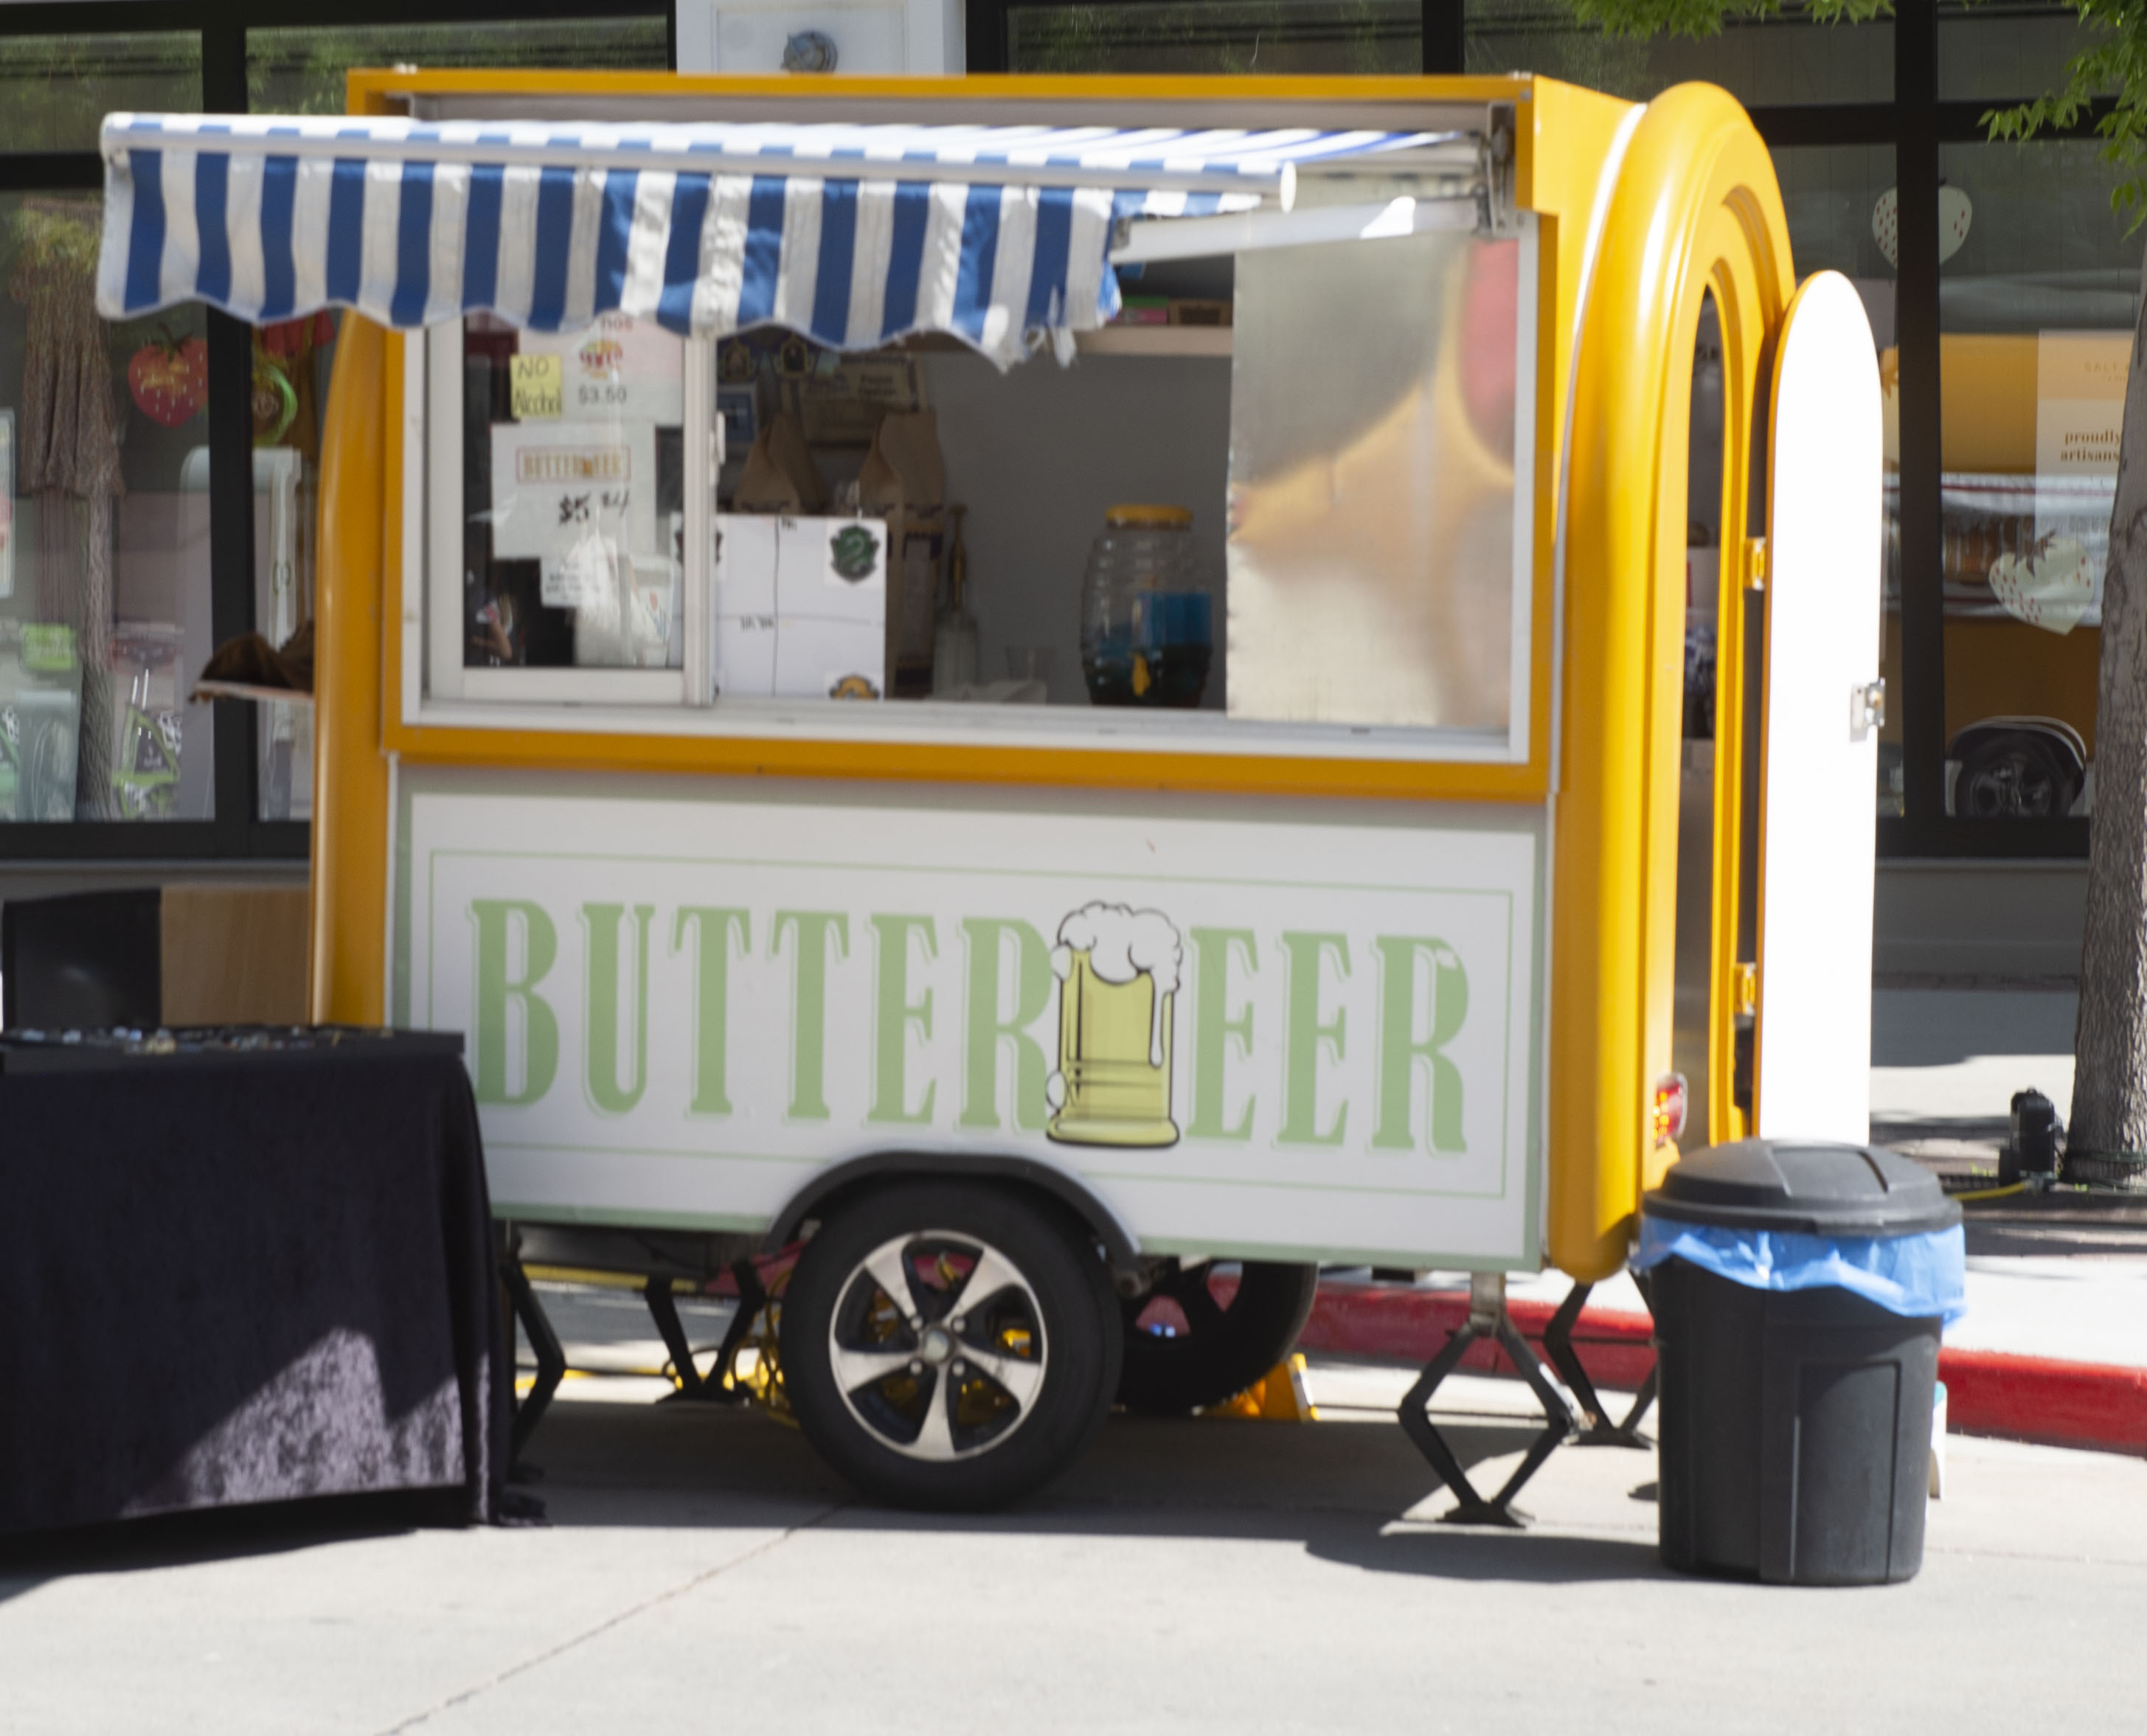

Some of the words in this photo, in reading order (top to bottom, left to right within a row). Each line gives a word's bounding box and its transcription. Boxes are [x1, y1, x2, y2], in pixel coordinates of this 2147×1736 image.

[518, 358, 549, 379] NO
[2064, 429, 2120, 445] proudly
[2061, 448, 2119, 462] artisans
